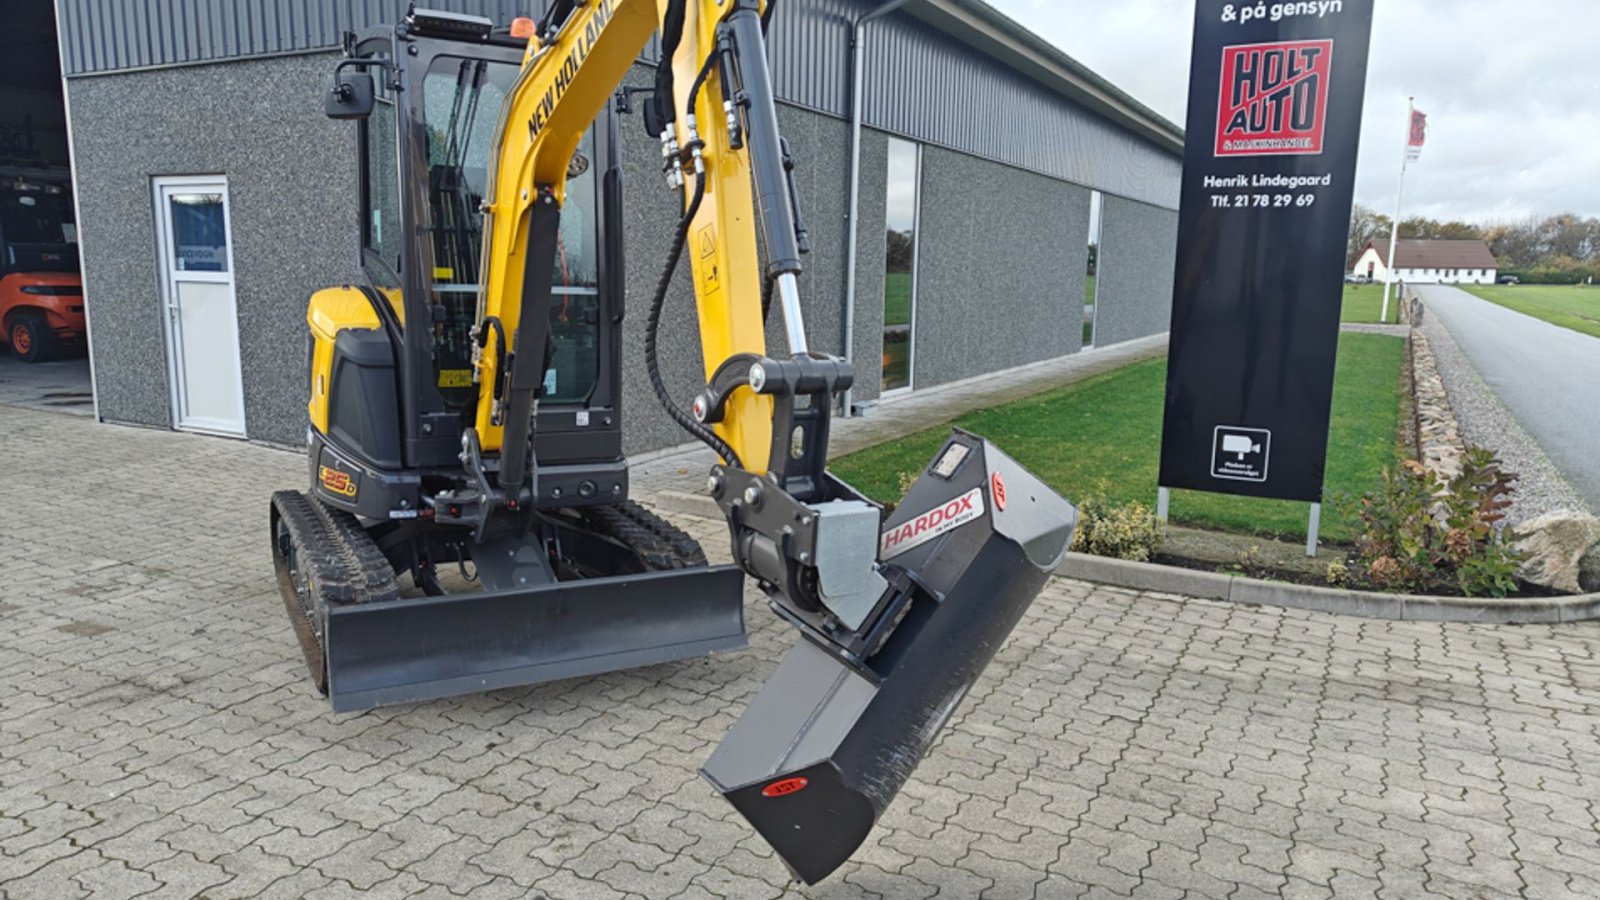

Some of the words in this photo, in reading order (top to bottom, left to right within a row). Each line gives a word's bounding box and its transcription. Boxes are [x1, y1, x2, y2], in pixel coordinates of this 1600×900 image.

[1221, 4, 1237, 22] &
[1240, 1, 1266, 24] på
[1270, 0, 1343, 20] gensyn
[1224, 72, 1320, 134] AUTO
[1231, 48, 1321, 108] HOLT
[528, 85, 555, 142] NEW
[1204, 174, 1248, 188] Henrik
[1252, 173, 1331, 189] Lindegaard
[1211, 195, 1230, 207] Tlf.
[1234, 195, 1249, 207] 21
[1252, 194, 1270, 207] 78
[1273, 194, 1292, 207] 29
[1296, 194, 1315, 207] 69
[884, 491, 973, 550] HARDOX
